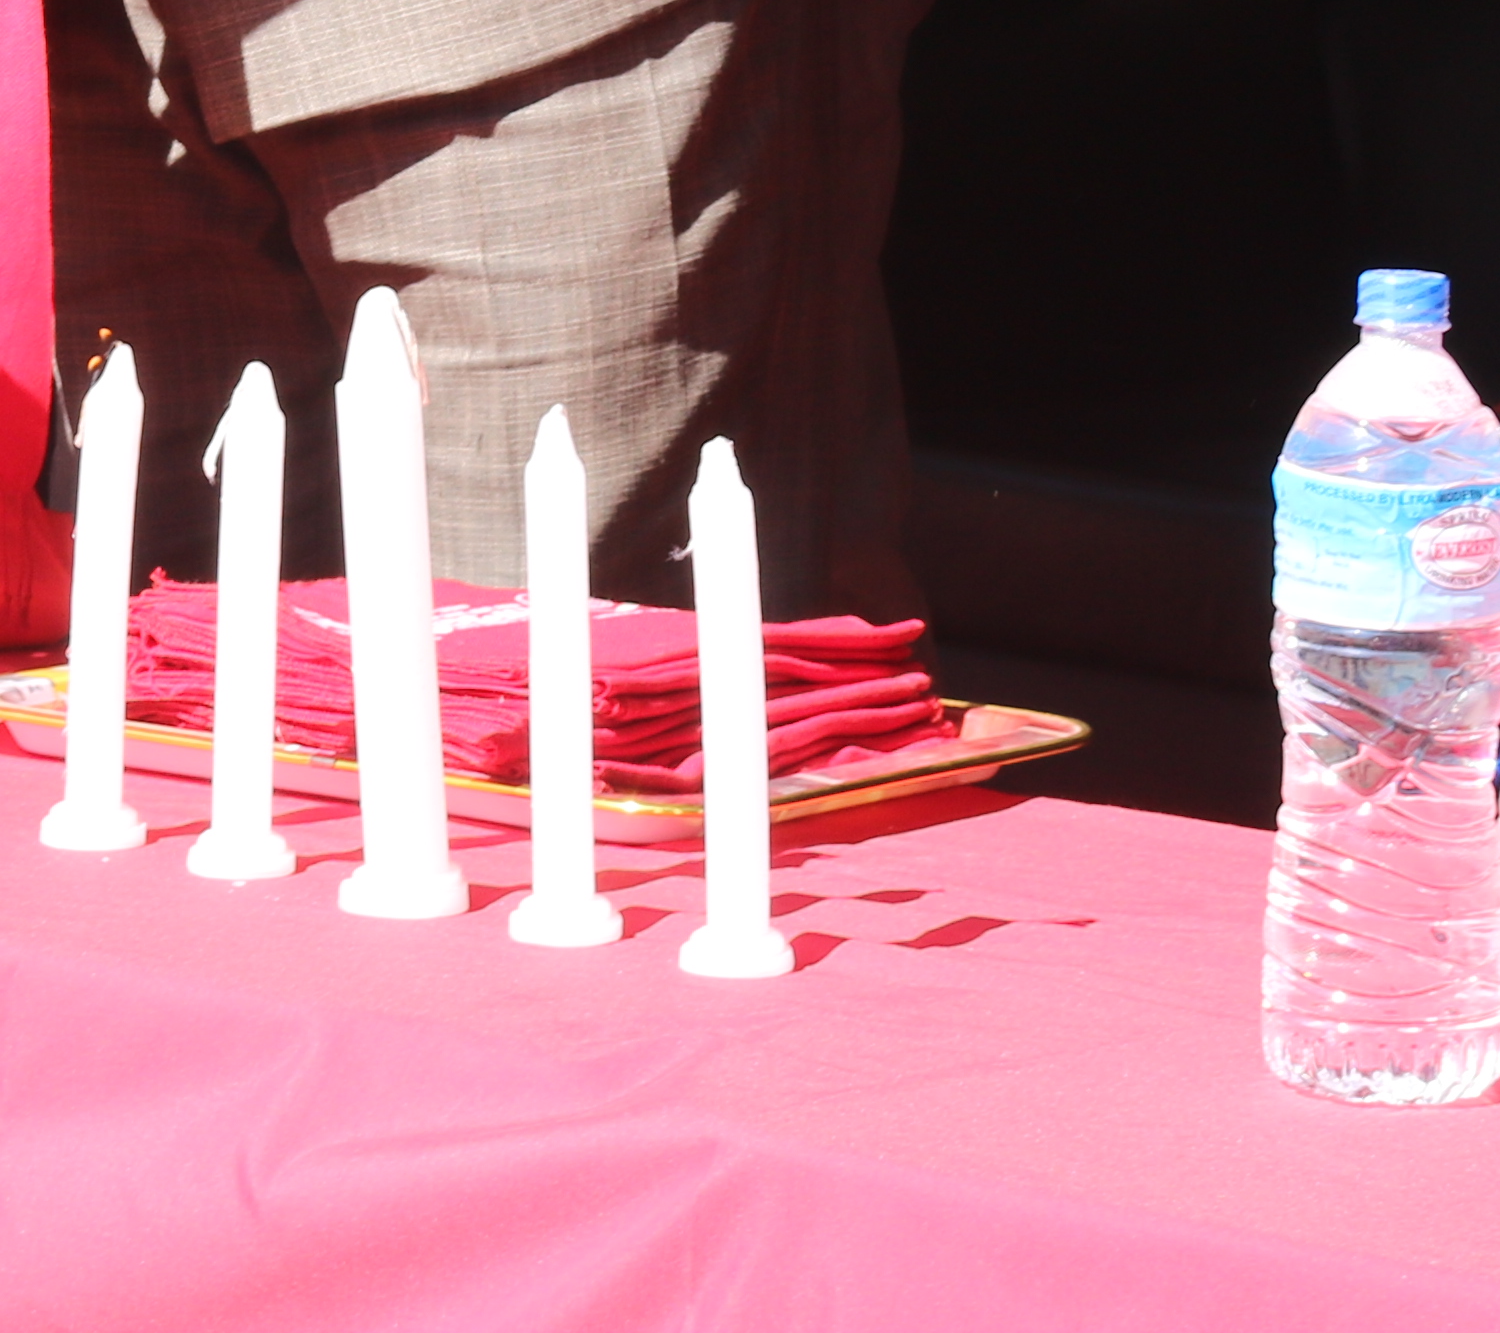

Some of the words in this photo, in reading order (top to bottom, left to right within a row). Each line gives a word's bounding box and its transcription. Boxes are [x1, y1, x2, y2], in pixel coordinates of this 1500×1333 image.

[1303, 481, 1376, 505] PROCESSED
[1377, 492, 1396, 507] BY
[1434, 537, 1497, 560] EVEREST
